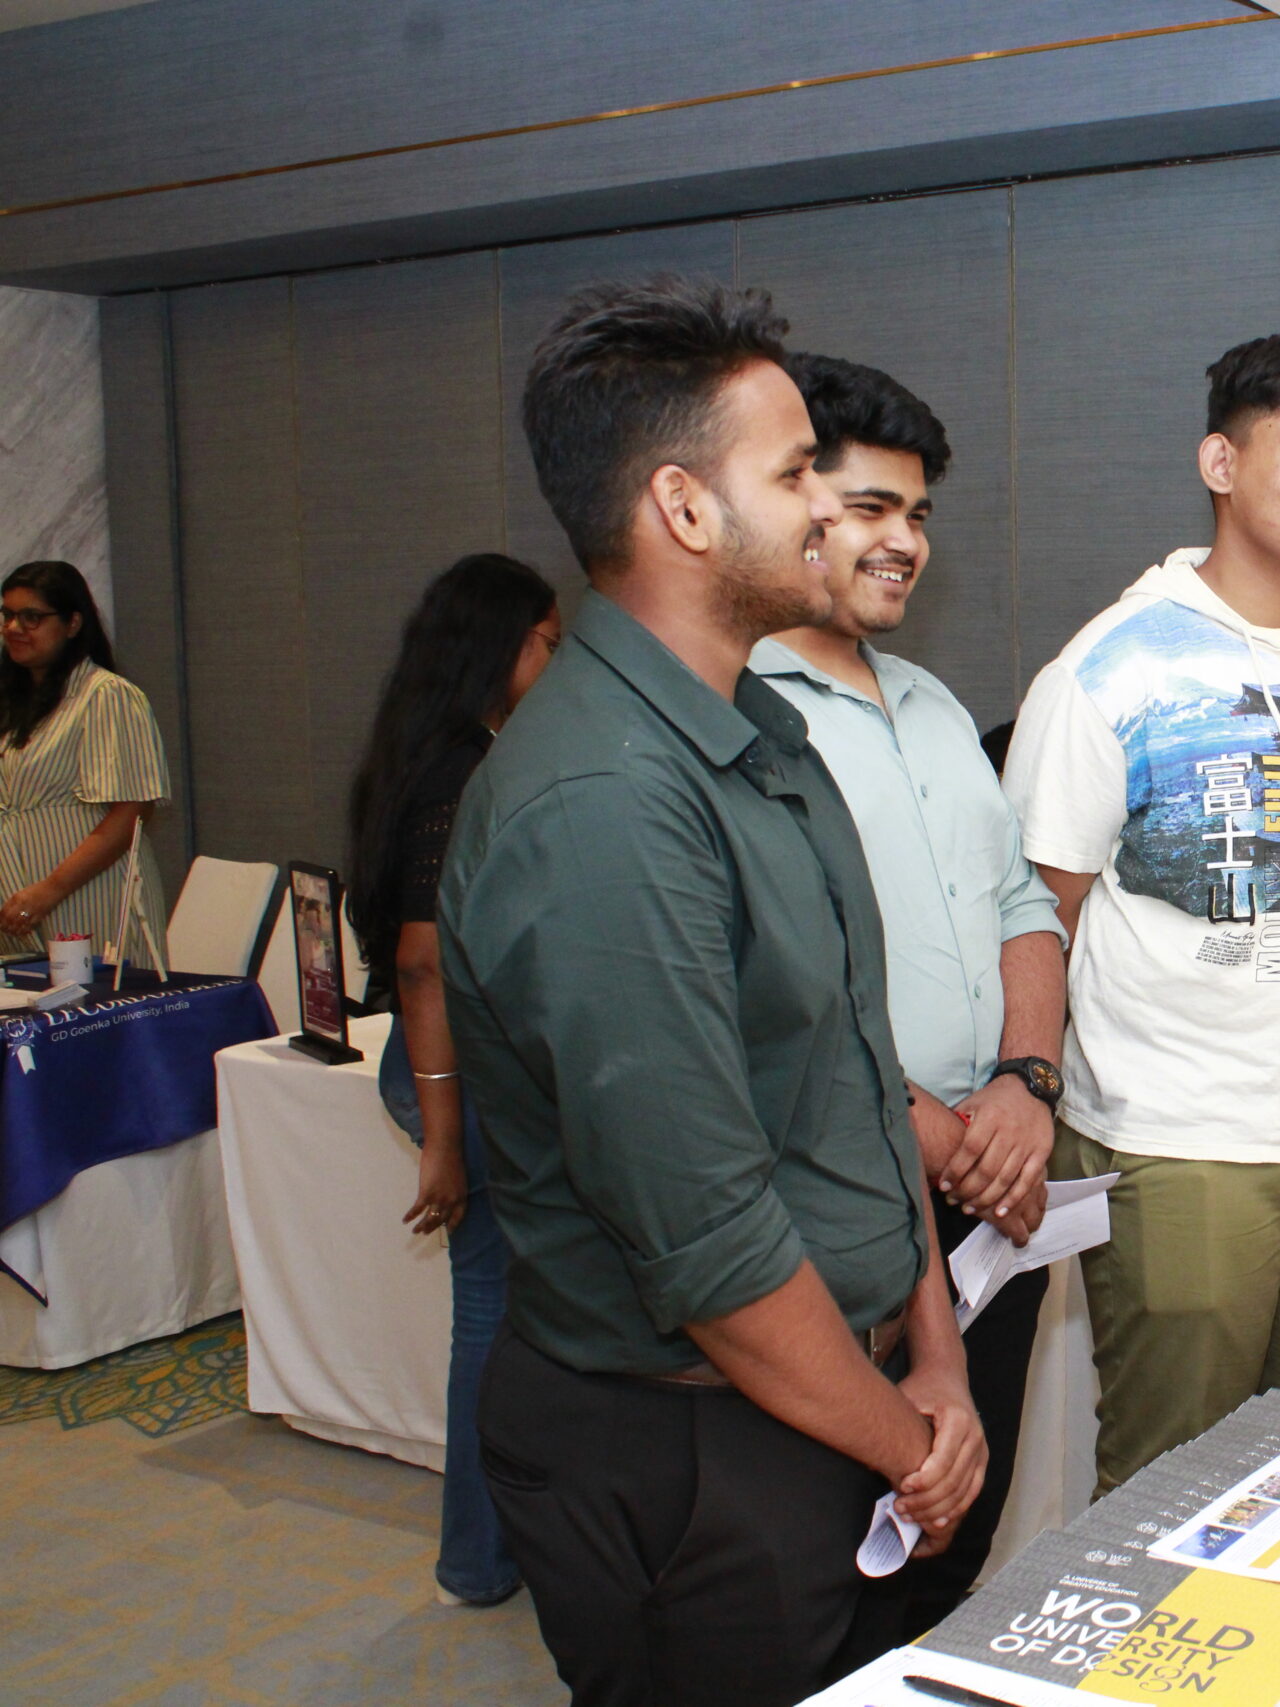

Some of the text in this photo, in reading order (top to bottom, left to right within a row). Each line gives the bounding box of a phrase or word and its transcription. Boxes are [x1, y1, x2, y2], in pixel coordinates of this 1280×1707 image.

[1196, 753, 1256, 926] 富士山
[51, 1030, 68, 1042] GD
[70, 1019, 111, 1037] Goenka
[112, 1004, 164, 1025] University,
[164, 1000, 190, 1012] India
[1059, 1579, 1139, 1597] CREATIVE EDUCATION
[1072, 1575, 1108, 1586] UNIVERSE
[1009, 1612, 1233, 1671] UNIVERSITY
[1039, 1589, 1255, 1651] WORLD
[990, 1634, 1217, 1694] OF DESIGN
